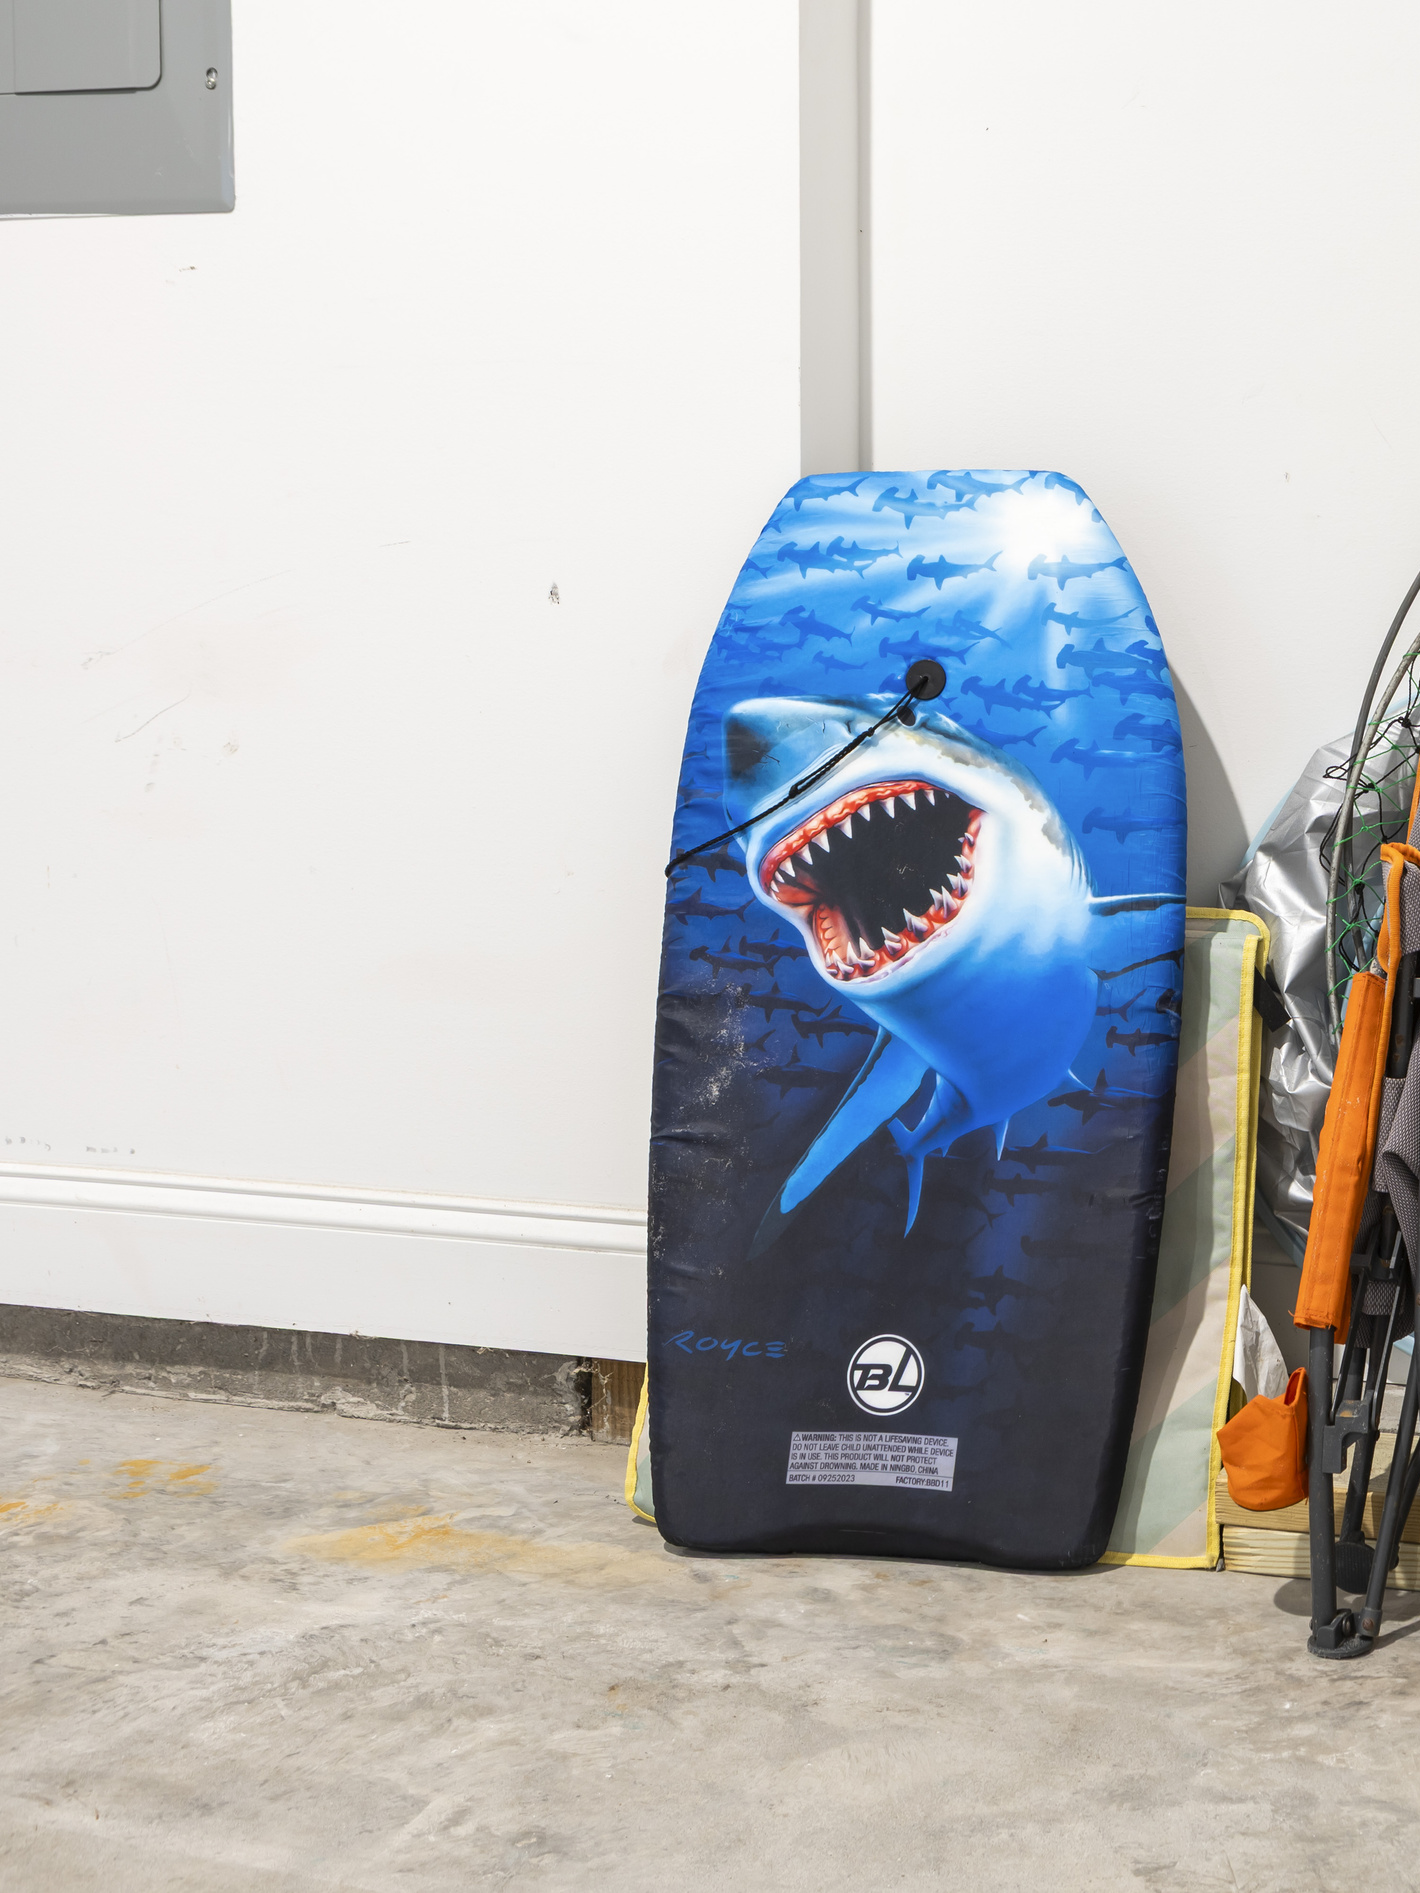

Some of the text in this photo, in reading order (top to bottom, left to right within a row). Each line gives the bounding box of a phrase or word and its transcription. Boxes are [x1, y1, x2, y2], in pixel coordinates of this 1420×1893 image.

[662, 1331, 786, 1361] ROYCE
[801, 1433, 949, 1447] WARNING: THIS IS NOT A LIFESAVING DEVICE.
[792, 1443, 954, 1457] DO NOT LEAVE CHILD UNATTENDED WHILE DEVICE
[791, 1452, 798, 1460] IS
[798, 1452, 806, 1460] IN
[840, 1452, 872, 1461] PRODUCT
[873, 1453, 889, 1462] WILL
[890, 1454, 905, 1463] NOT
[905, 1455, 938, 1465] PROTECT
[788, 1461, 819, 1470] AGAINST
[819, 1461, 858, 1470] DROWNING.
[859, 1462, 879, 1471] MADE
[881, 1463, 888, 1471] IN
[917, 1465, 939, 1475] CHINA
[788, 1474, 811, 1482] BATCH
[811, 1474, 817, 1482] #
[817, 1474, 856, 1483] 09252023
